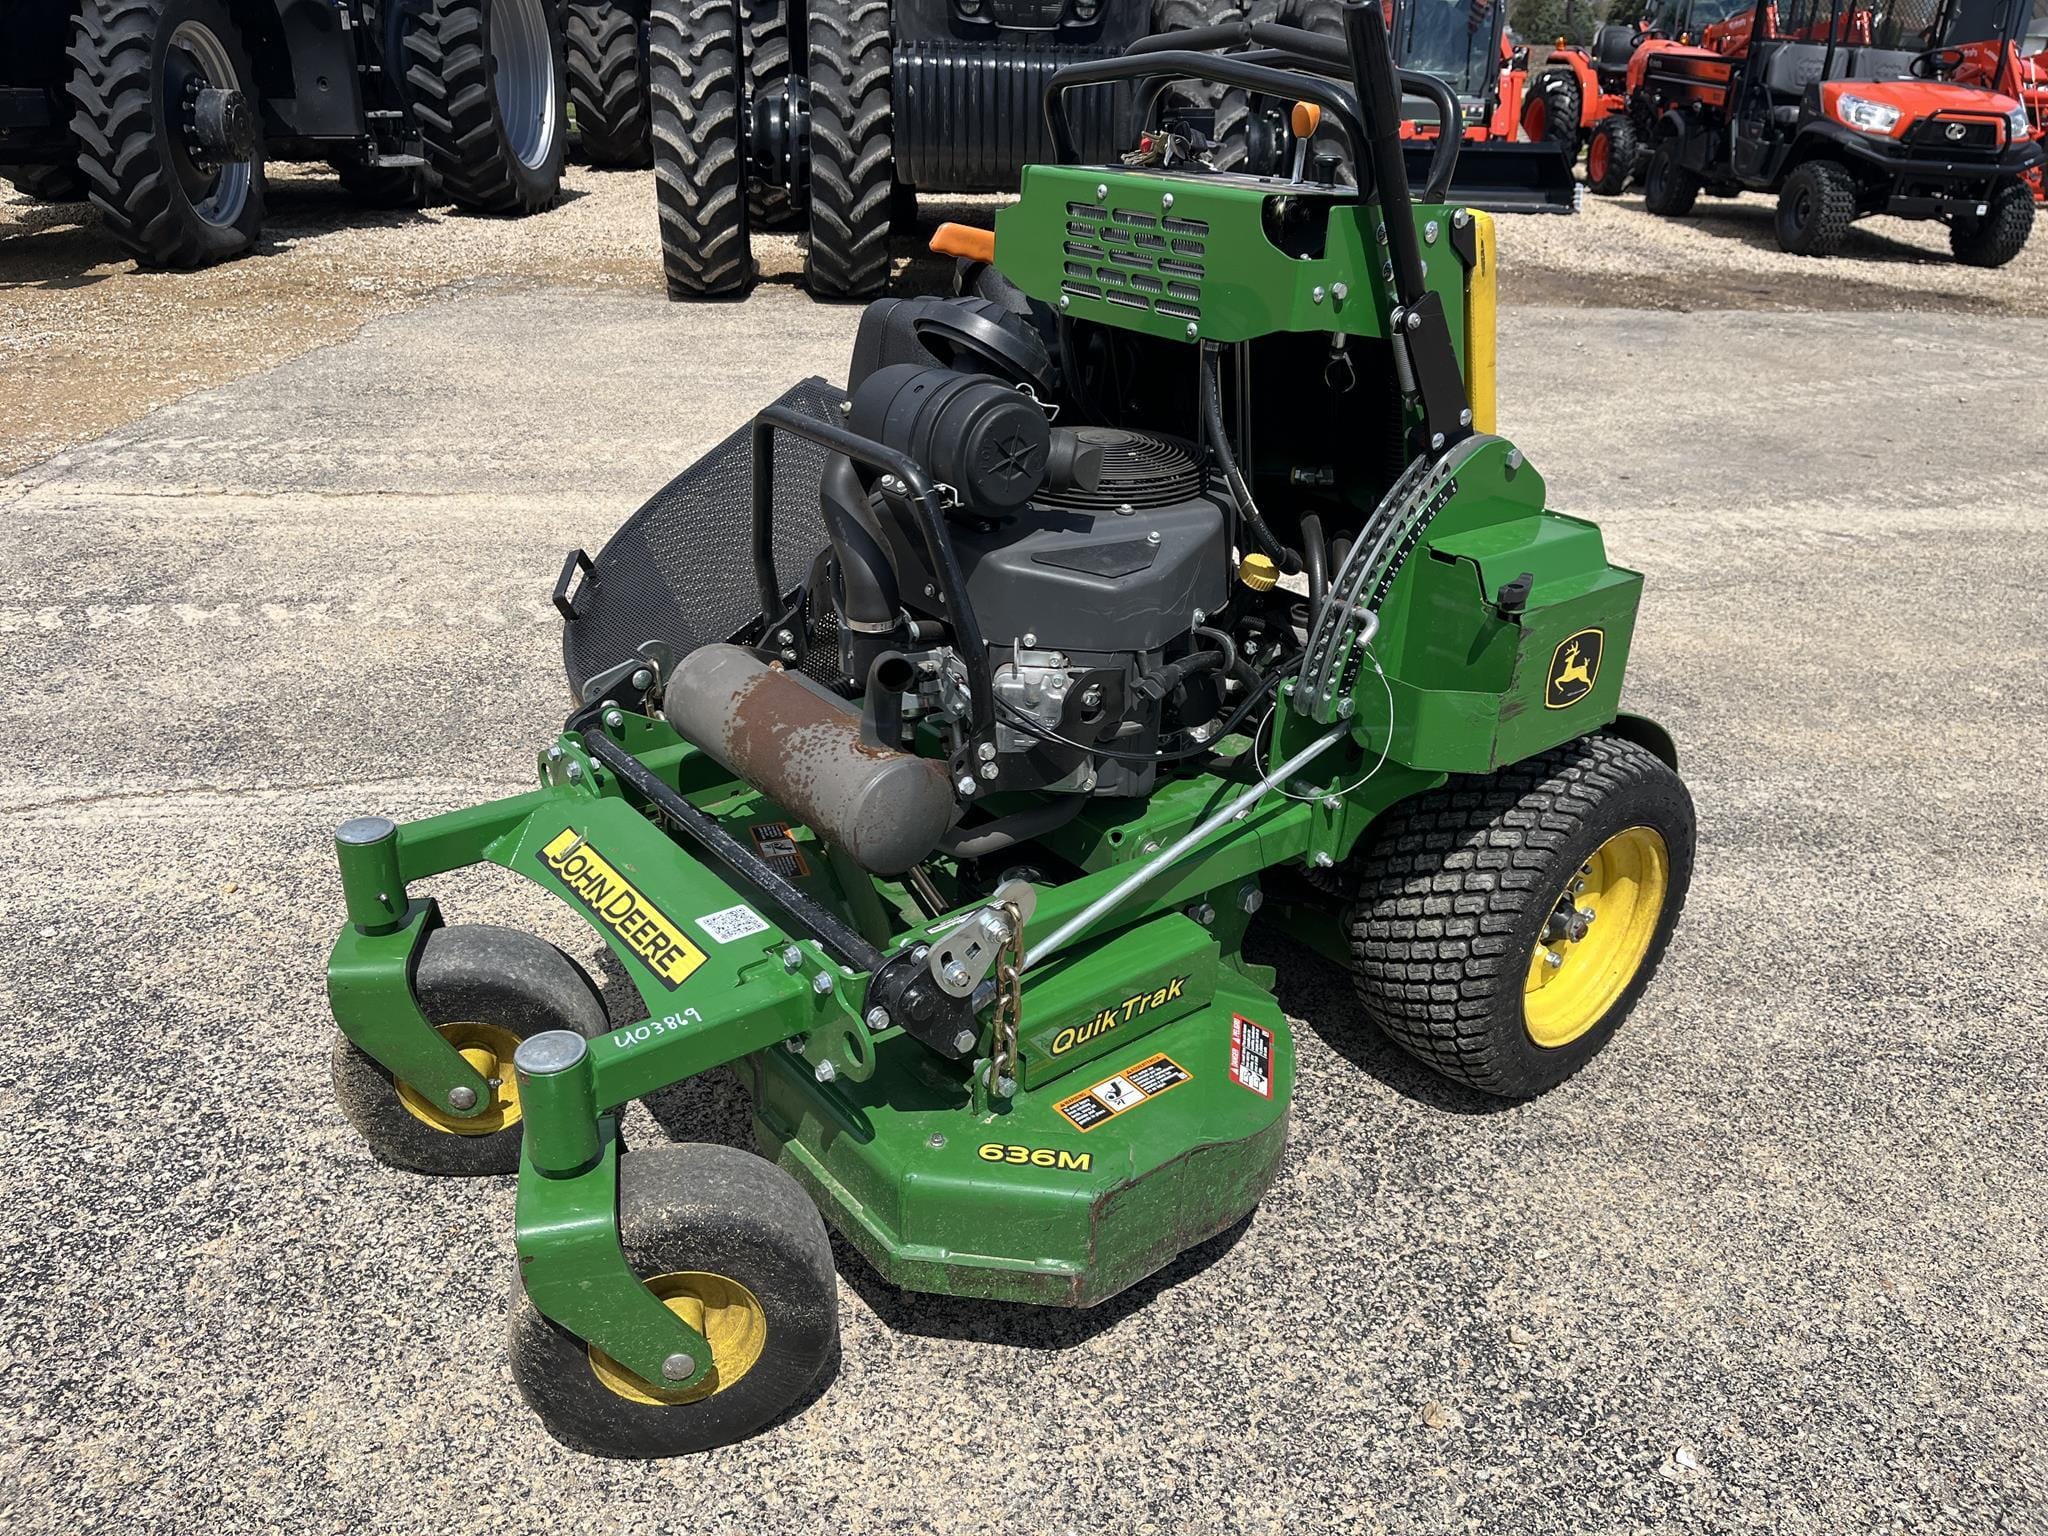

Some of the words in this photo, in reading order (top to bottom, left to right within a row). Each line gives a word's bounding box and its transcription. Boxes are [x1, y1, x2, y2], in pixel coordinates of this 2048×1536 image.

[551, 845, 616, 905] JOHN
[603, 889, 687, 973] DEERE
[978, 1143, 1093, 1172] 636M
